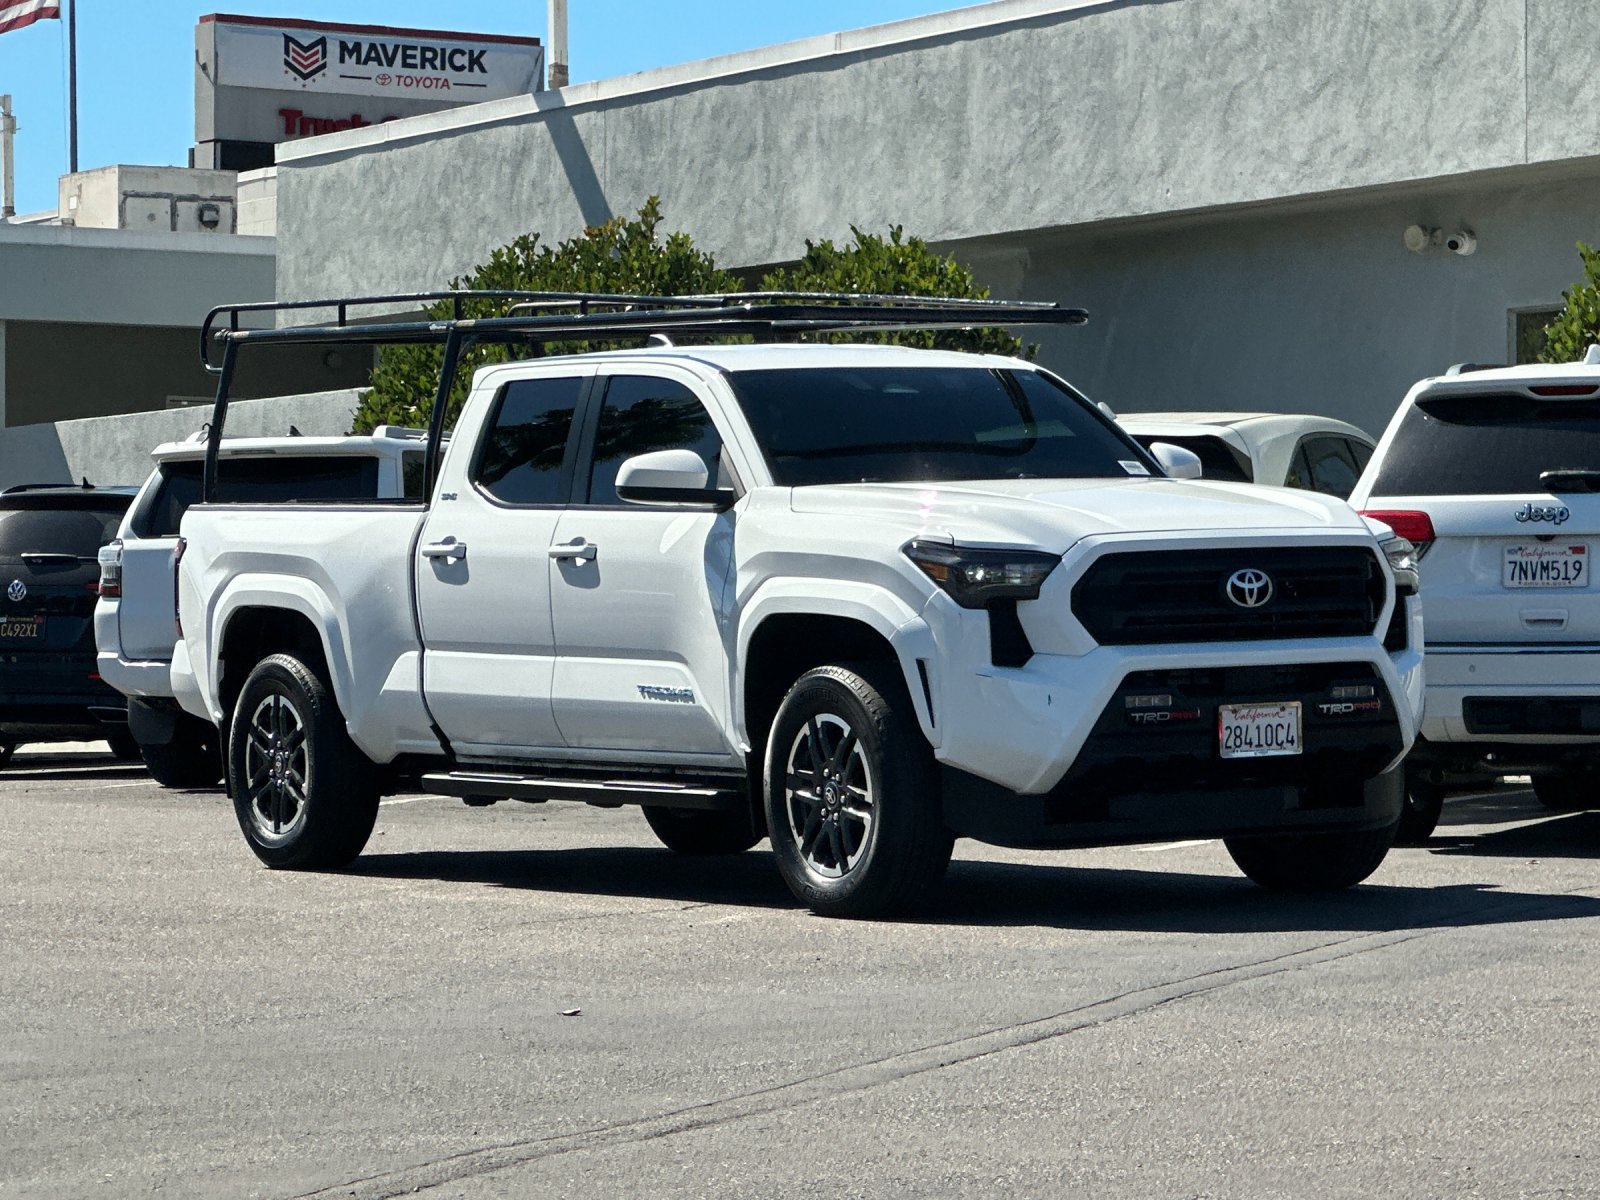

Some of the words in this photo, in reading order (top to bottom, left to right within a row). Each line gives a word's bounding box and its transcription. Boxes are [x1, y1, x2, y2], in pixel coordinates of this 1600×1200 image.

[338, 40, 488, 74] MAVERICK
[395, 75, 451, 90] TOYOTA
[1515, 503, 1570, 526] Jeep
[1508, 560, 1583, 581] 7NVM519
[1225, 723, 1295, 749] 28410C4
